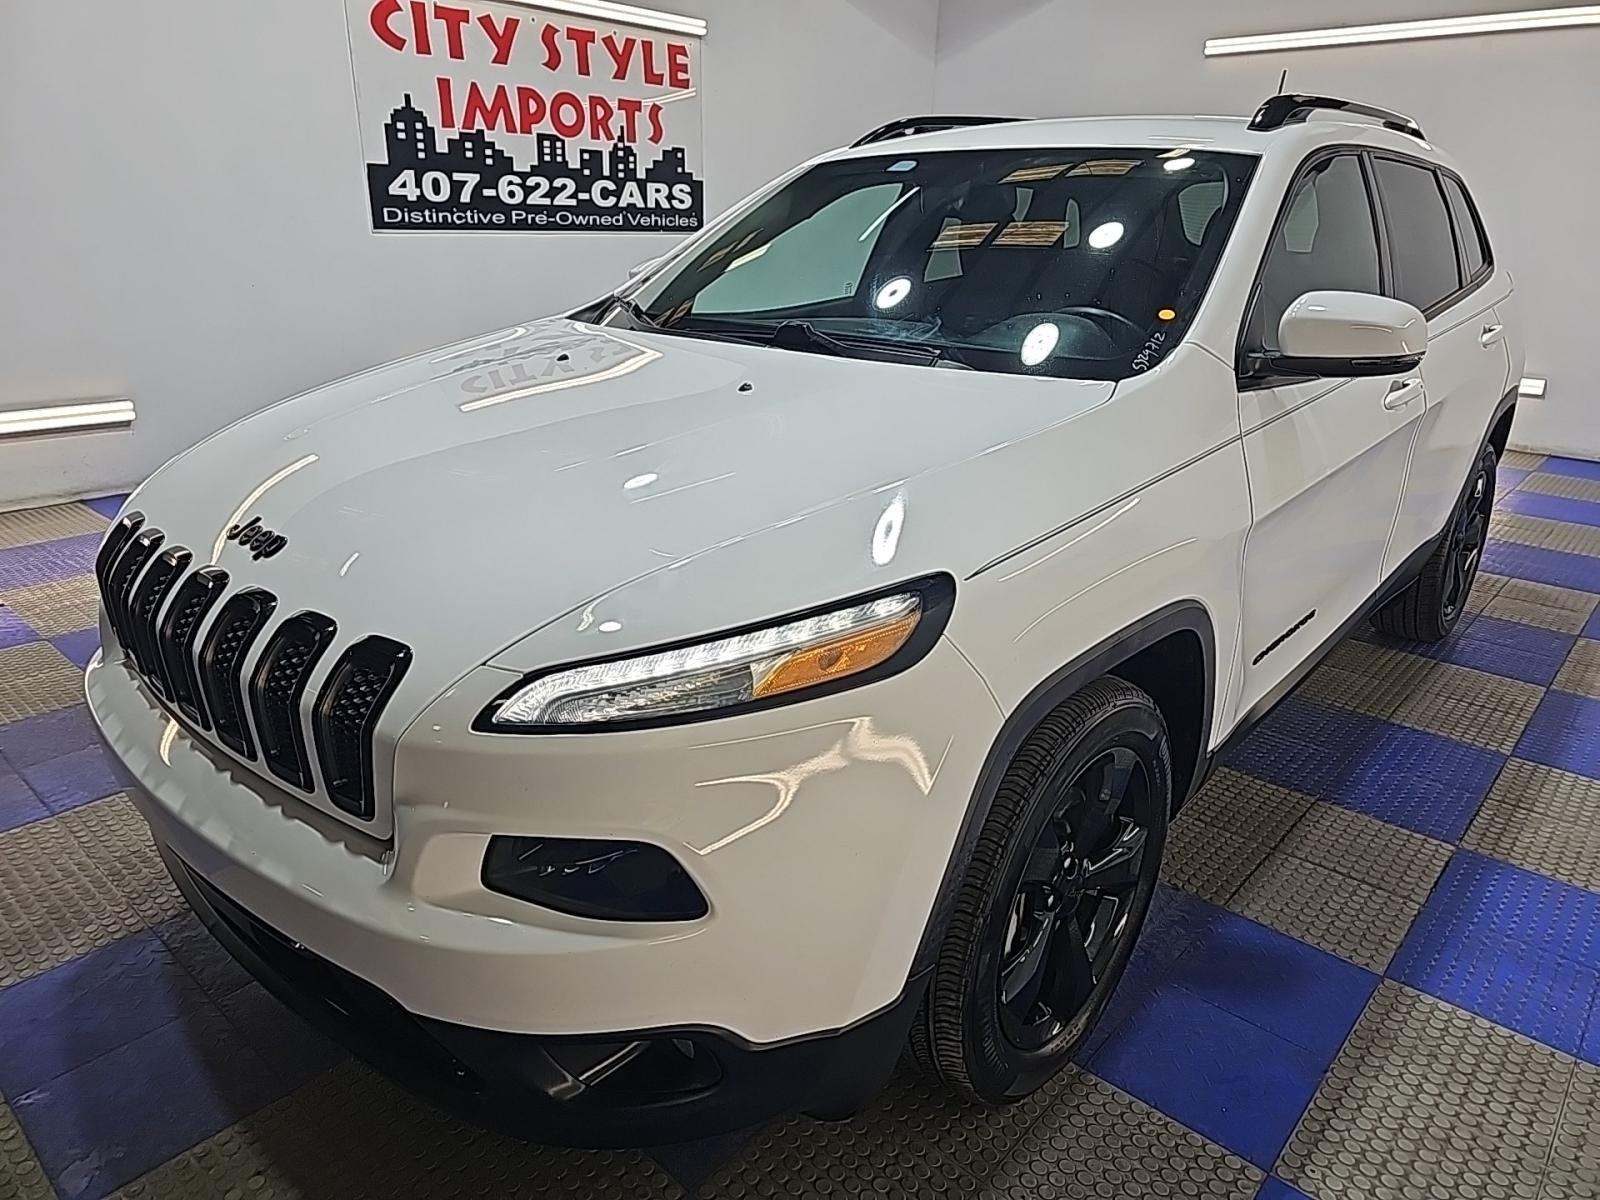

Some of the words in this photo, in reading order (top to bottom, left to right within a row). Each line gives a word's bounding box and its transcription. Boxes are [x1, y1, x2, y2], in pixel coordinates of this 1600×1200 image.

[370, 0, 520, 65] CITY
[541, 23, 690, 90] STYLE
[435, 77, 664, 145] IMPORTS
[388, 169, 692, 210] 407-622-CARS
[383, 207, 505, 224] Distinctive
[511, 210, 623, 226] Pre-Owned
[627, 214, 698, 227] Vehicles
[226, 516, 288, 561] Jeep
